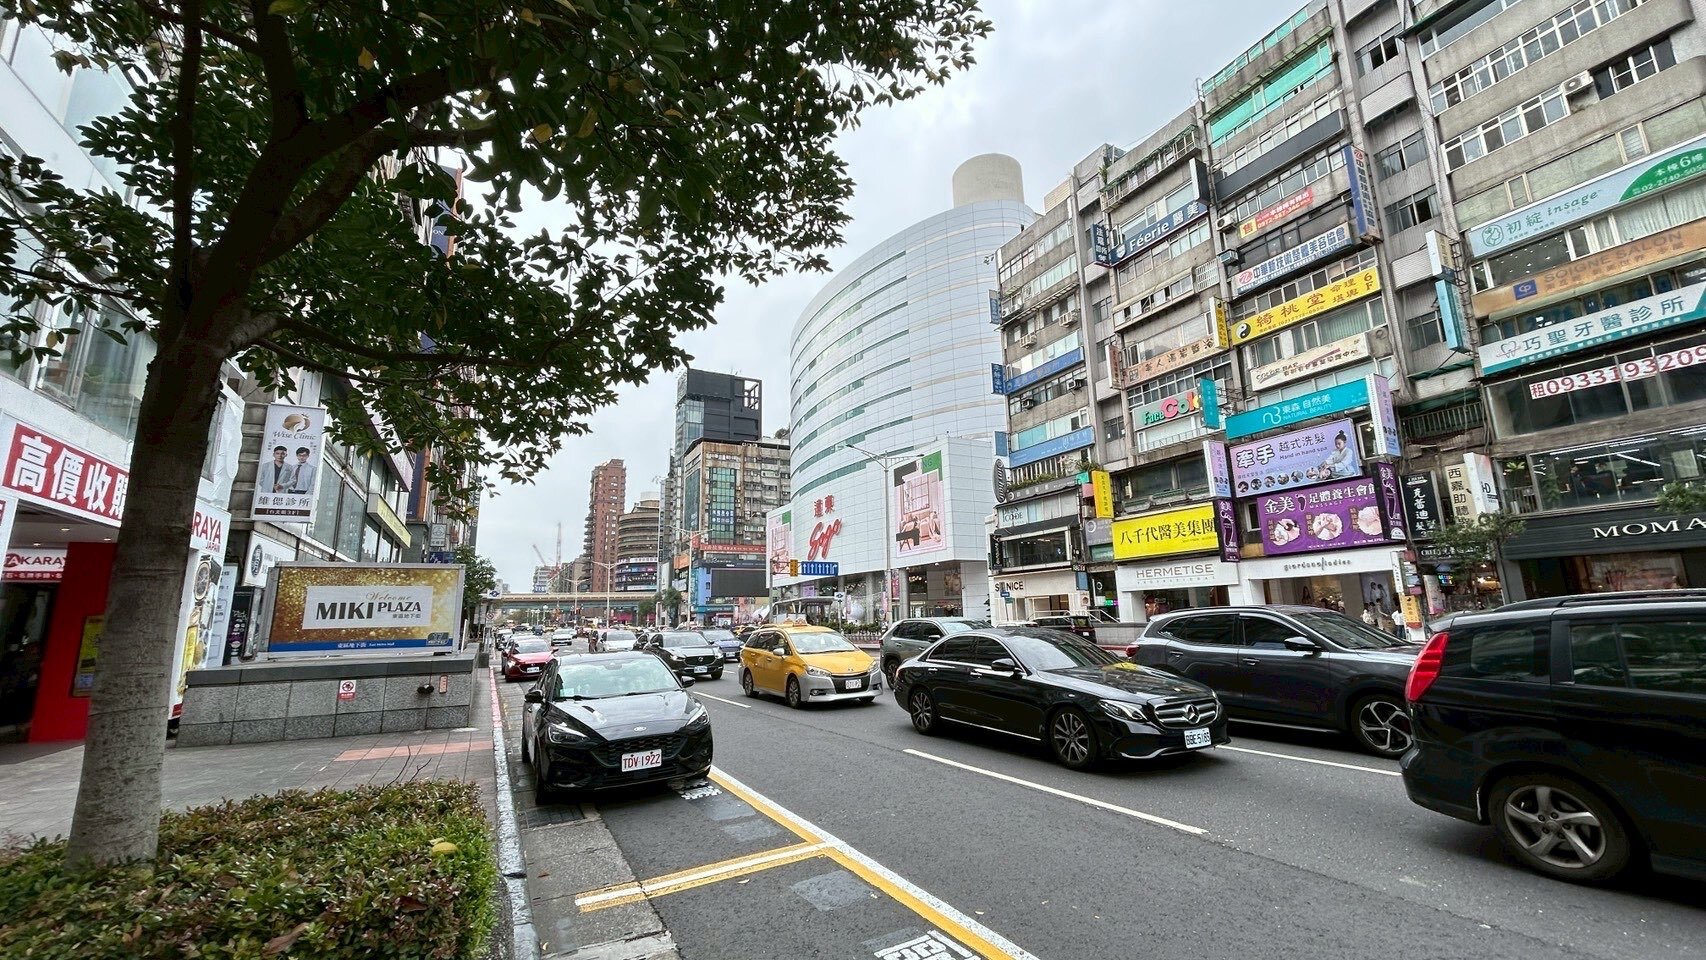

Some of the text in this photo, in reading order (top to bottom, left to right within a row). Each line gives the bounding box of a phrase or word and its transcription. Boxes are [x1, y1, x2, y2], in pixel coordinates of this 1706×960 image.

[1548, 191, 1598, 216] insage
[1129, 222, 1170, 251] Féerie
[1173, 201, 1199, 226] 醫美
[1543, 256, 1614, 282] SOIGNE
[1616, 231, 1682, 260] SALON
[1330, 278, 1357, 292] 命理
[1363, 272, 1374, 290] 6F
[1523, 296, 1684, 351] 巧聖牙醫診所
[1283, 394, 1331, 414] 東森 自然美
[1284, 403, 1331, 420] NATURAL BEAUTY
[273, 431, 292, 439] Wise
[1236, 443, 1275, 468] 牽手
[1279, 432, 1325, 452] 越式洗髮
[814, 494, 835, 518] 遠東
[1265, 496, 1296, 514] 金美
[191, 512, 221, 544] RAYA
[1120, 518, 1214, 545] 八千代醫美集團
[1136, 563, 1214, 578] HERMETISE
[366, 592, 411, 601] Welcome
[316, 602, 421, 620] MIKI PLAZA
[623, 754, 661, 769] TDV-1922
